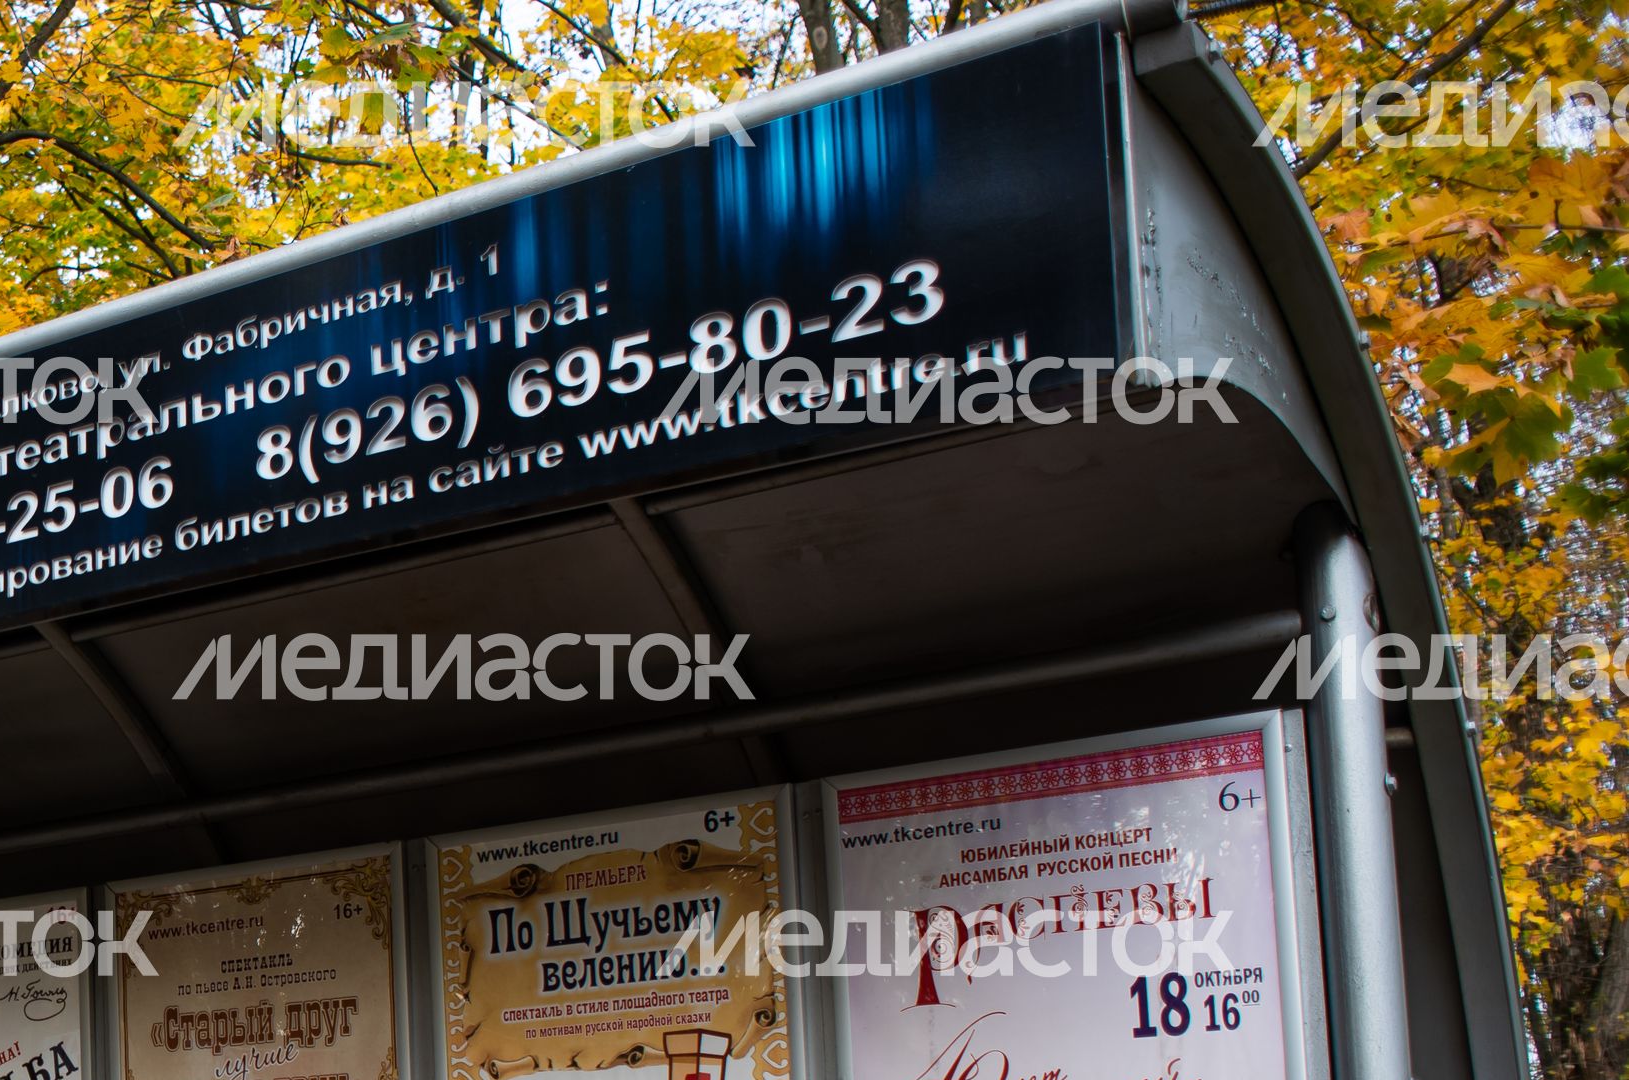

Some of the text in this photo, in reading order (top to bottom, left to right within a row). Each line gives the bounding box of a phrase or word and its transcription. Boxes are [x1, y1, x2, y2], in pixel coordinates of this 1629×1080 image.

[115, 347, 172, 386] ул.
[182, 279, 412, 362] Фабричная,
[425, 265, 465, 299] д.
[479, 243, 499, 276] 1
[370, 279, 610, 377] центра:
[255, 375, 479, 484] 8(926)
[508, 258, 945, 419] 695-80-23
[174, 491, 348, 552] билетов
[362, 474, 413, 510] на
[428, 441, 564, 493] сайте
[577, 330, 1028, 459] www.tkcentre.ru
[476, 809, 735, 863] www.tkcentre.ru 6+
[842, 780, 1262, 850] www.tkcentre.ru 6+
[939, 847, 1178, 888] АНСАМБЛЯ РУССКОЙ ПЕСНИ
[960, 827, 1153, 865] ЮБИЛЕЙНЫЙ КОНЦЕРТ
[566, 864, 647, 892] ПРЕМЬЕРА
[148, 902, 363, 941] www.tkcentre.ru 16+
[487, 896, 721, 955] По Щучьему
[221, 953, 293, 973] СПЕКТАКЛЬ
[150, 996, 359, 1056] «Старый друг
[525, 1012, 711, 1040] по мотивам русской народной сказки
[1129, 967, 1263, 1038] 18 ОКТЯБРЯ
